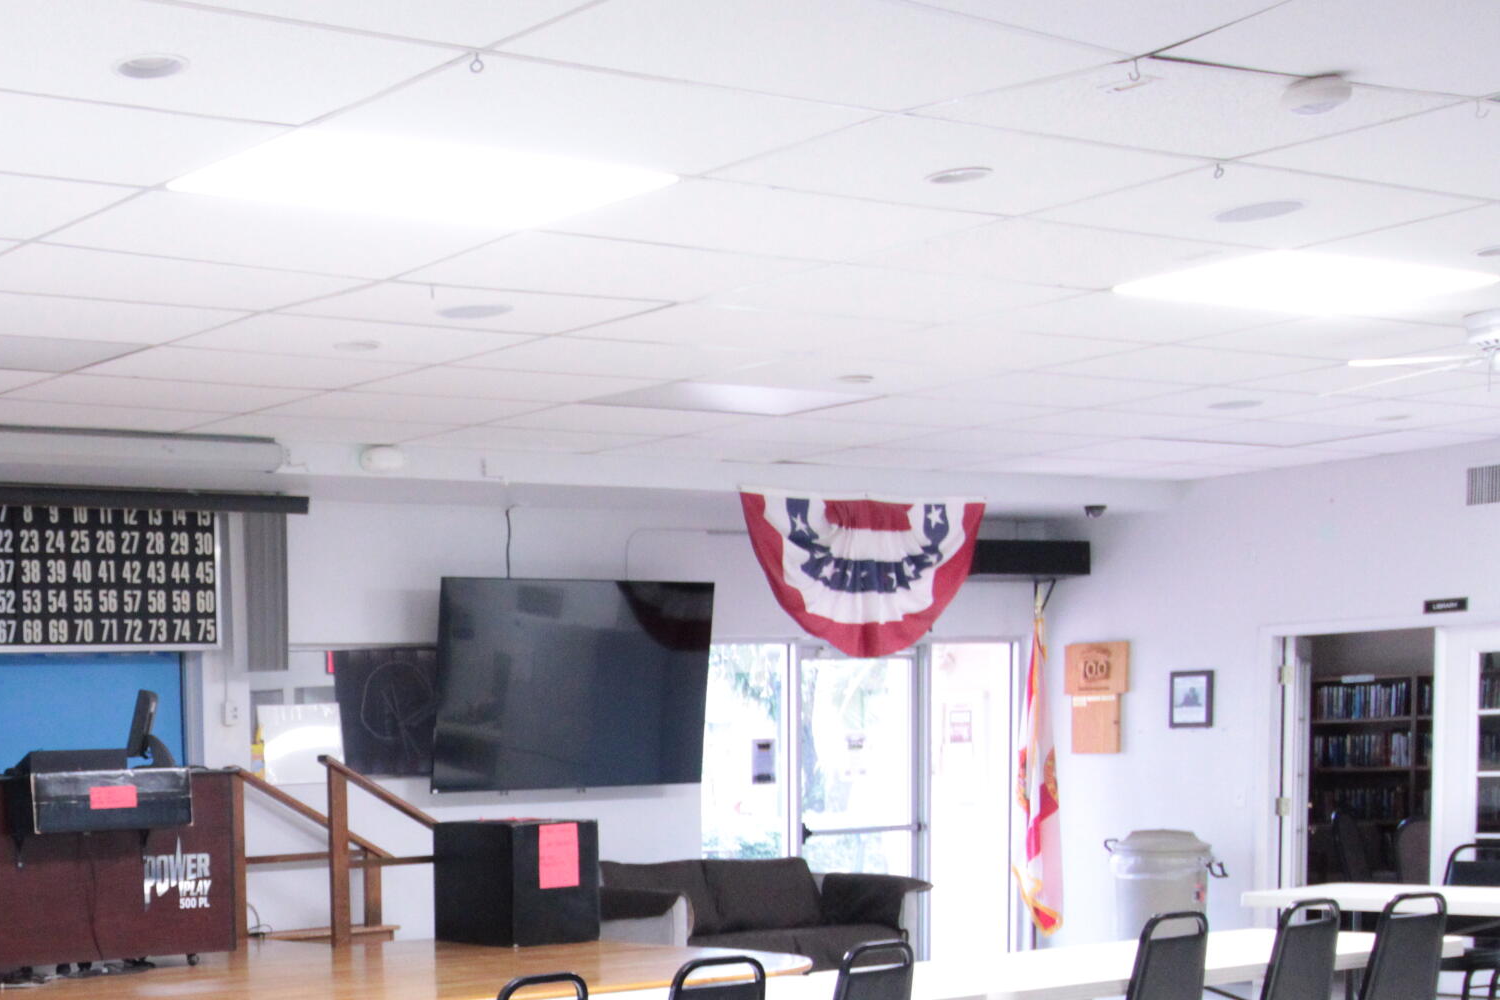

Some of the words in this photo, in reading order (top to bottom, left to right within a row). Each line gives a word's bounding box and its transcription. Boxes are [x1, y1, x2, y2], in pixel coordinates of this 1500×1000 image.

[23, 506, 33, 523] 8
[49, 506, 59, 523] 9
[74, 507, 87, 524] 10
[100, 508, 112, 524] 11
[124, 508, 137, 525] 12
[149, 509, 162, 525] 13
[173, 510, 186, 525] 14
[197, 510, 211, 526] 15
[20, 530, 39, 553] 23
[45, 530, 65, 553] 24
[71, 530, 89, 553] 25
[96, 531, 115, 553] 26
[121, 531, 139, 554] 27
[146, 532, 164, 554] 28
[171, 532, 189, 555] 29
[195, 533, 212, 555] 30
[22, 560, 40, 583] 38
[47, 560, 66, 583] 39
[73, 560, 91, 583] 40
[98, 560, 115, 582] 41
[123, 561, 141, 583] 42
[147, 561, 165, 584] 43
[171, 562, 190, 583] 44
[196, 562, 213, 583] 45
[23, 590, 41, 613] 53
[48, 590, 67, 613] 54
[74, 590, 92, 612] 55
[99, 590, 117, 612] 56
[124, 590, 141, 613] 57
[148, 590, 166, 613] 58
[172, 590, 190, 613] 59
[197, 590, 214, 613] 60
[23, 620, 42, 643] 68
[49, 619, 68, 642] 69
[74, 619, 93, 642] 70
[101, 619, 117, 641] 71
[124, 619, 142, 642] 72
[149, 619, 167, 642] 73
[173, 619, 190, 641] 74
[197, 619, 215, 641] 75
[143, 838, 210, 910] POWER
[182, 879, 212, 897] PLAY
[179, 897, 197, 909] 500
